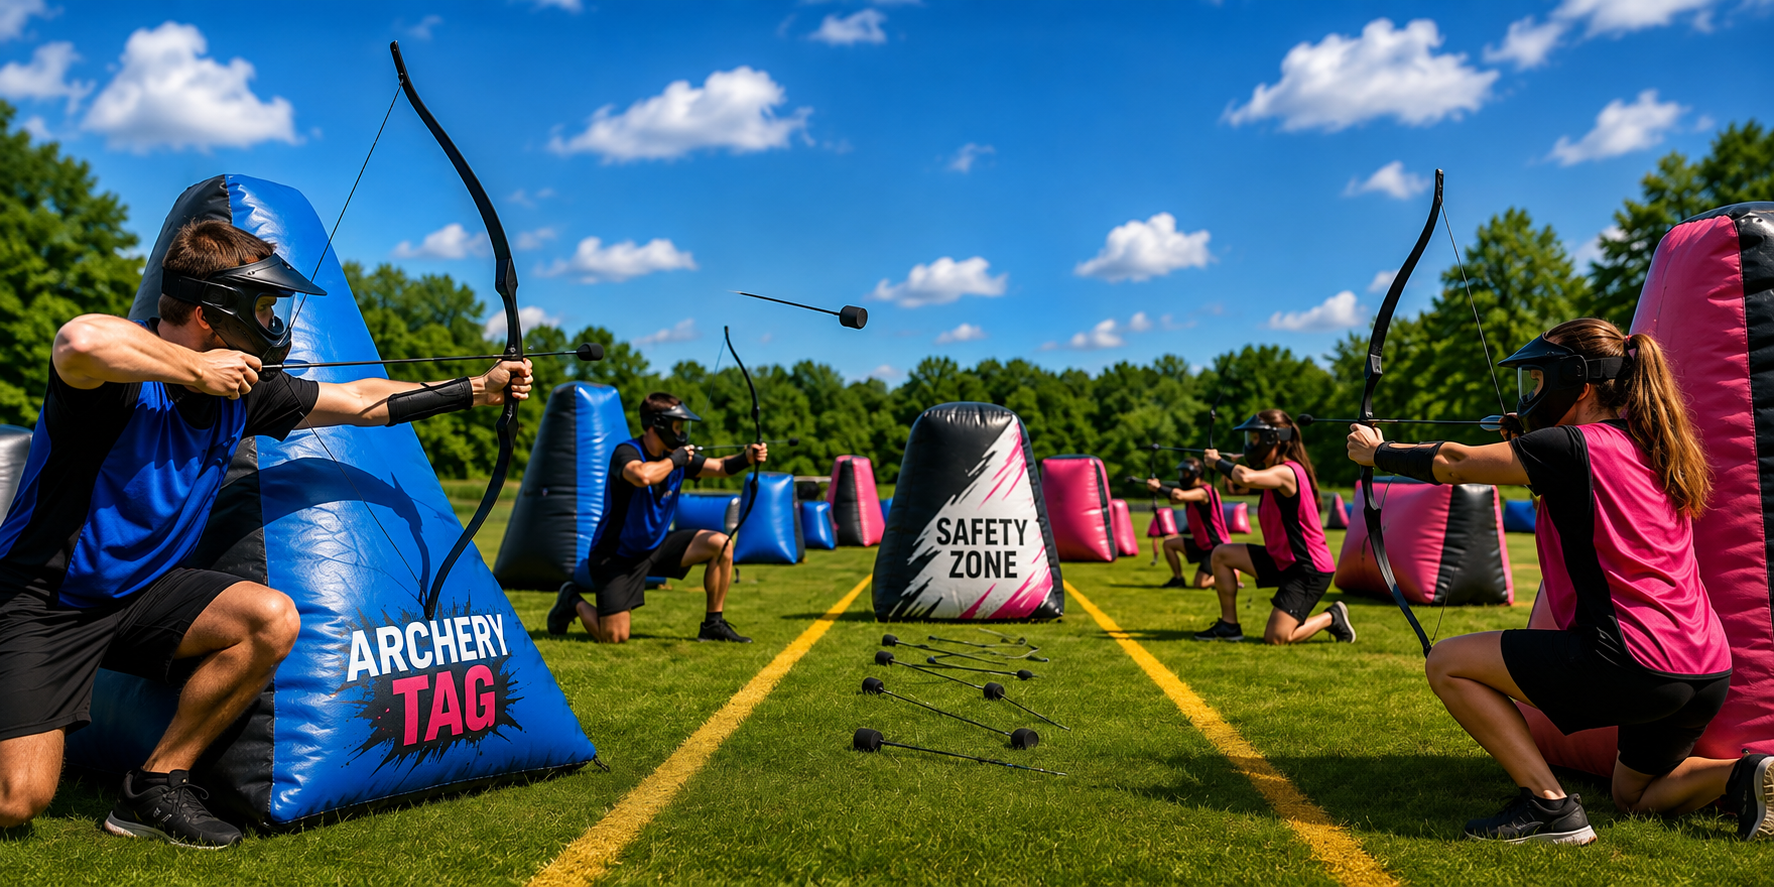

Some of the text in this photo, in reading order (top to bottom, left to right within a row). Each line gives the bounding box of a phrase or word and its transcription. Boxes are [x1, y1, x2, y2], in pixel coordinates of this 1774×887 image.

[936, 517, 1028, 546] SAFETY
[949, 551, 1018, 579] ZONE
[347, 613, 508, 682] ARCHERY
[392, 664, 496, 746] TAG
